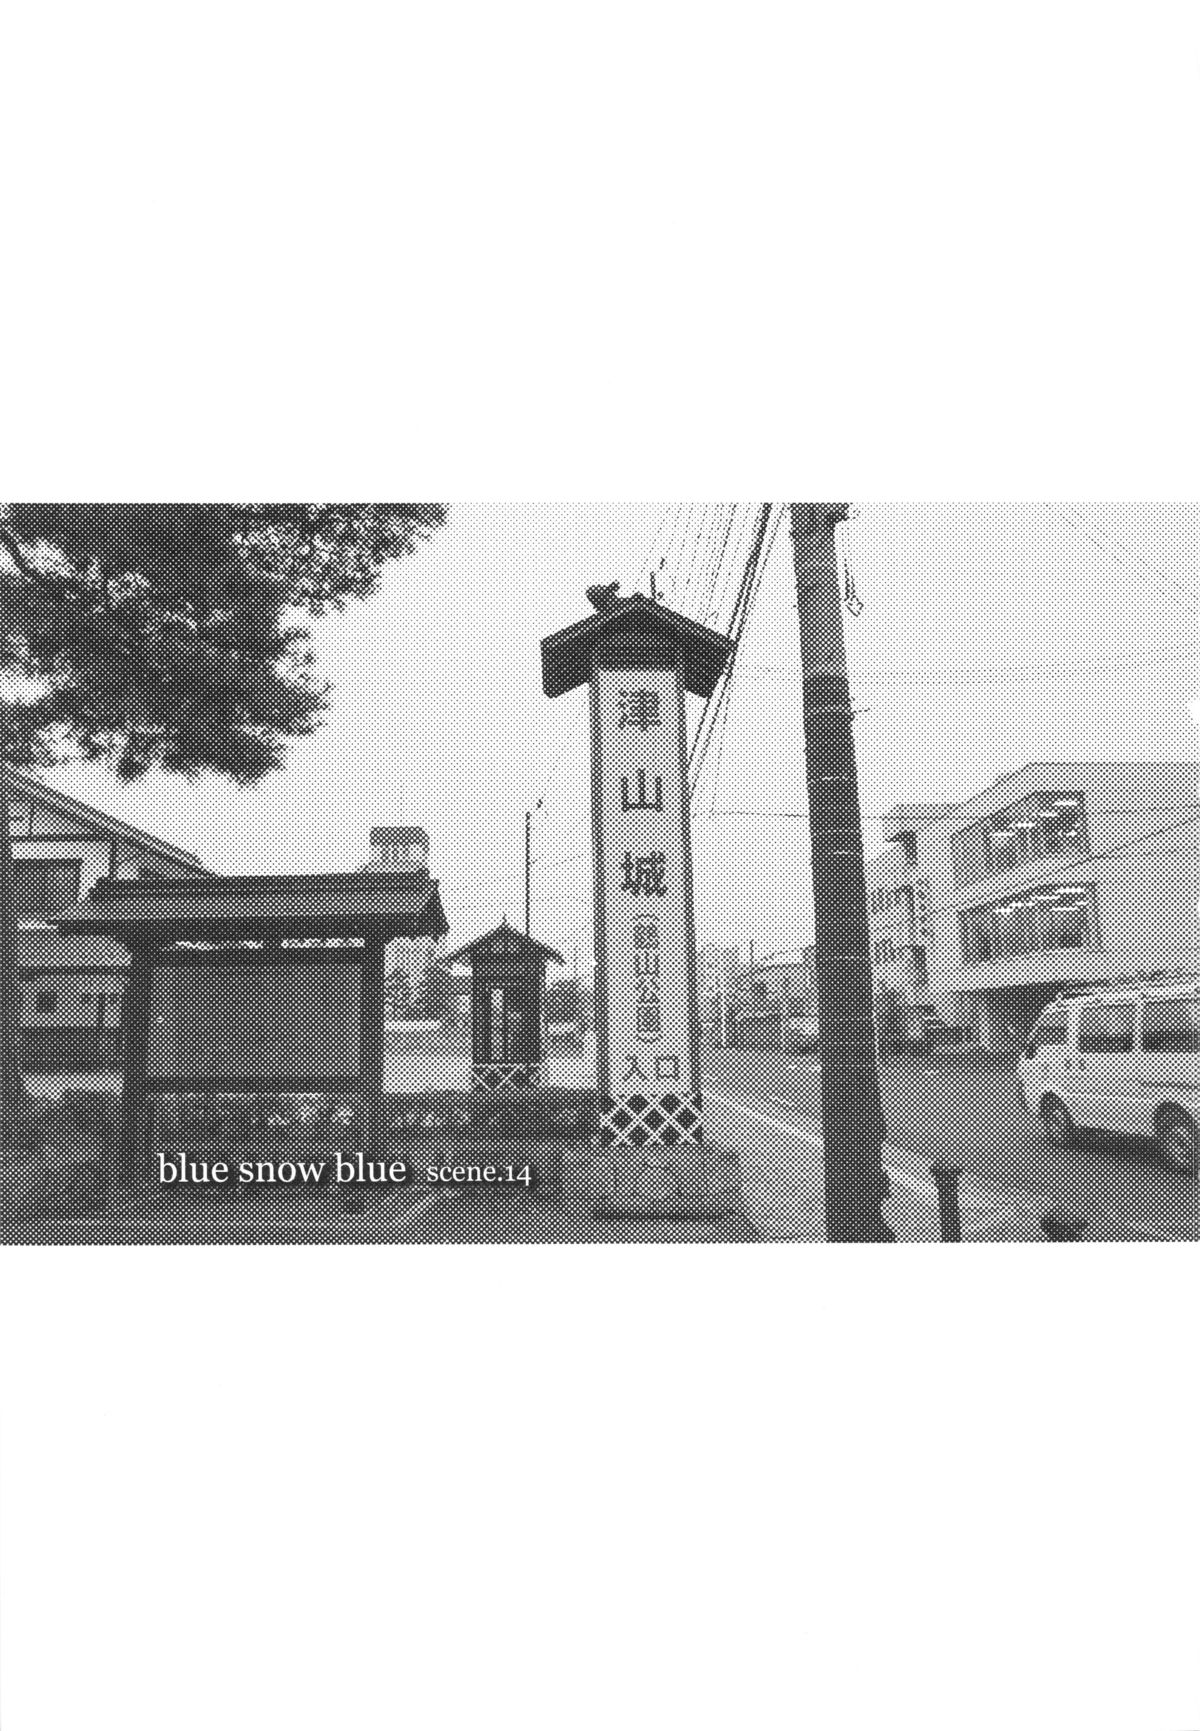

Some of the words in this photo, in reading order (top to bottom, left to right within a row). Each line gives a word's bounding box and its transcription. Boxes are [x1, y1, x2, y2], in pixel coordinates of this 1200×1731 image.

[617, 688, 669, 898] 津山城
[622, 1054, 681, 1082] 入口
